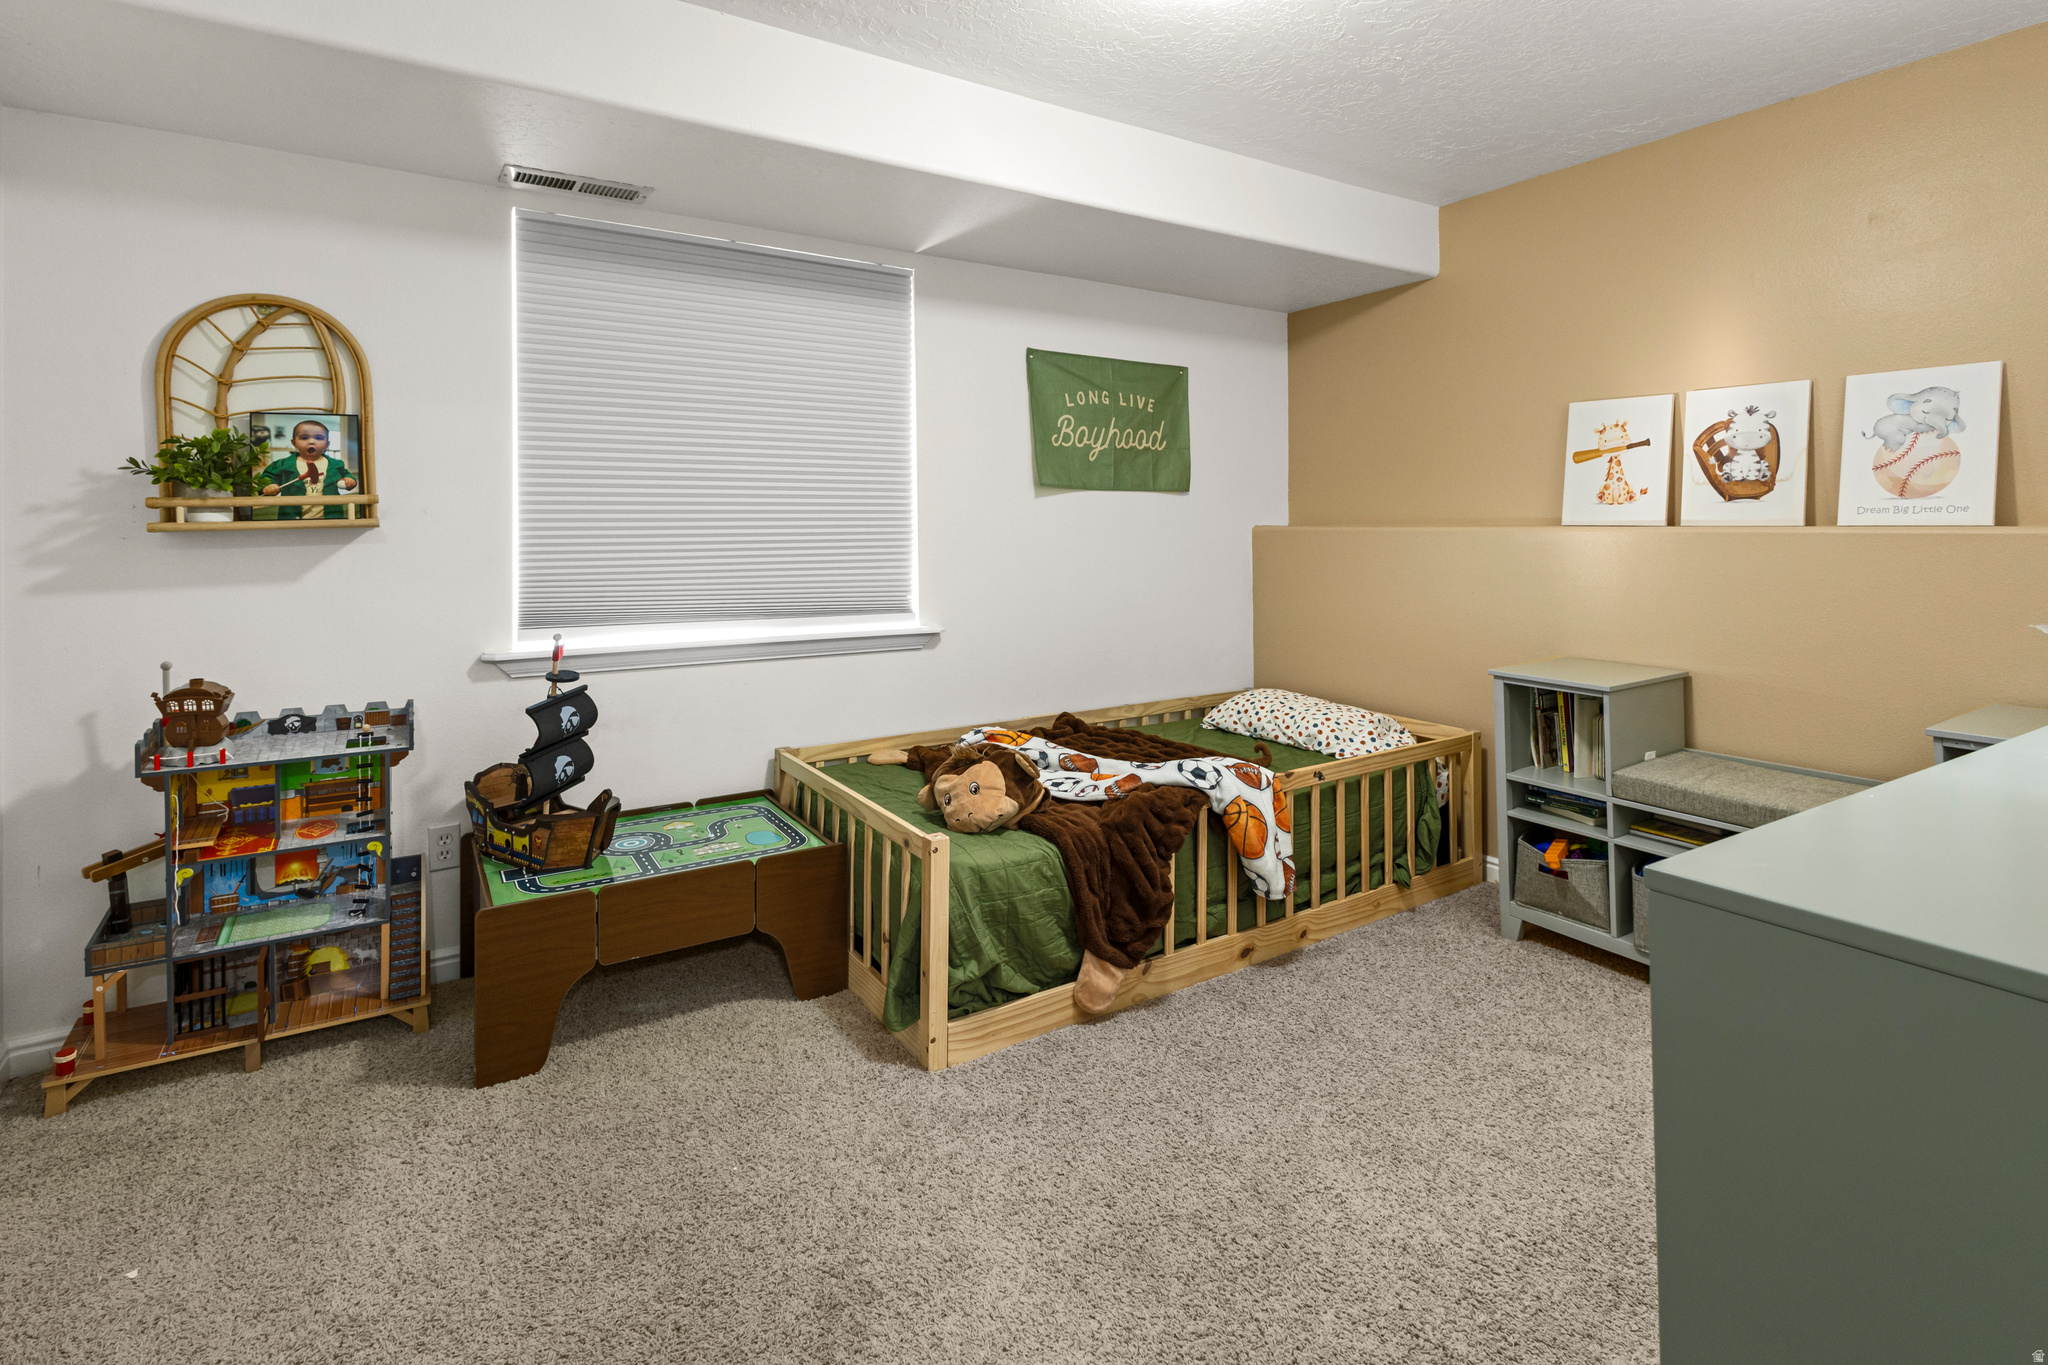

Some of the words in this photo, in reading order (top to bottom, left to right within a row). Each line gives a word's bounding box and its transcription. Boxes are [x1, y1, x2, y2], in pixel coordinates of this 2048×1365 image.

[1065, 390, 1109, 407] LONG
[1119, 392, 1155, 413] LIVE
[1051, 414, 1167, 462] Boyhood
[1856, 506, 1890, 515] Dream
[1893, 505, 1909, 515] Big
[1912, 505, 1943, 515] Little
[1946, 504, 1970, 514] One
